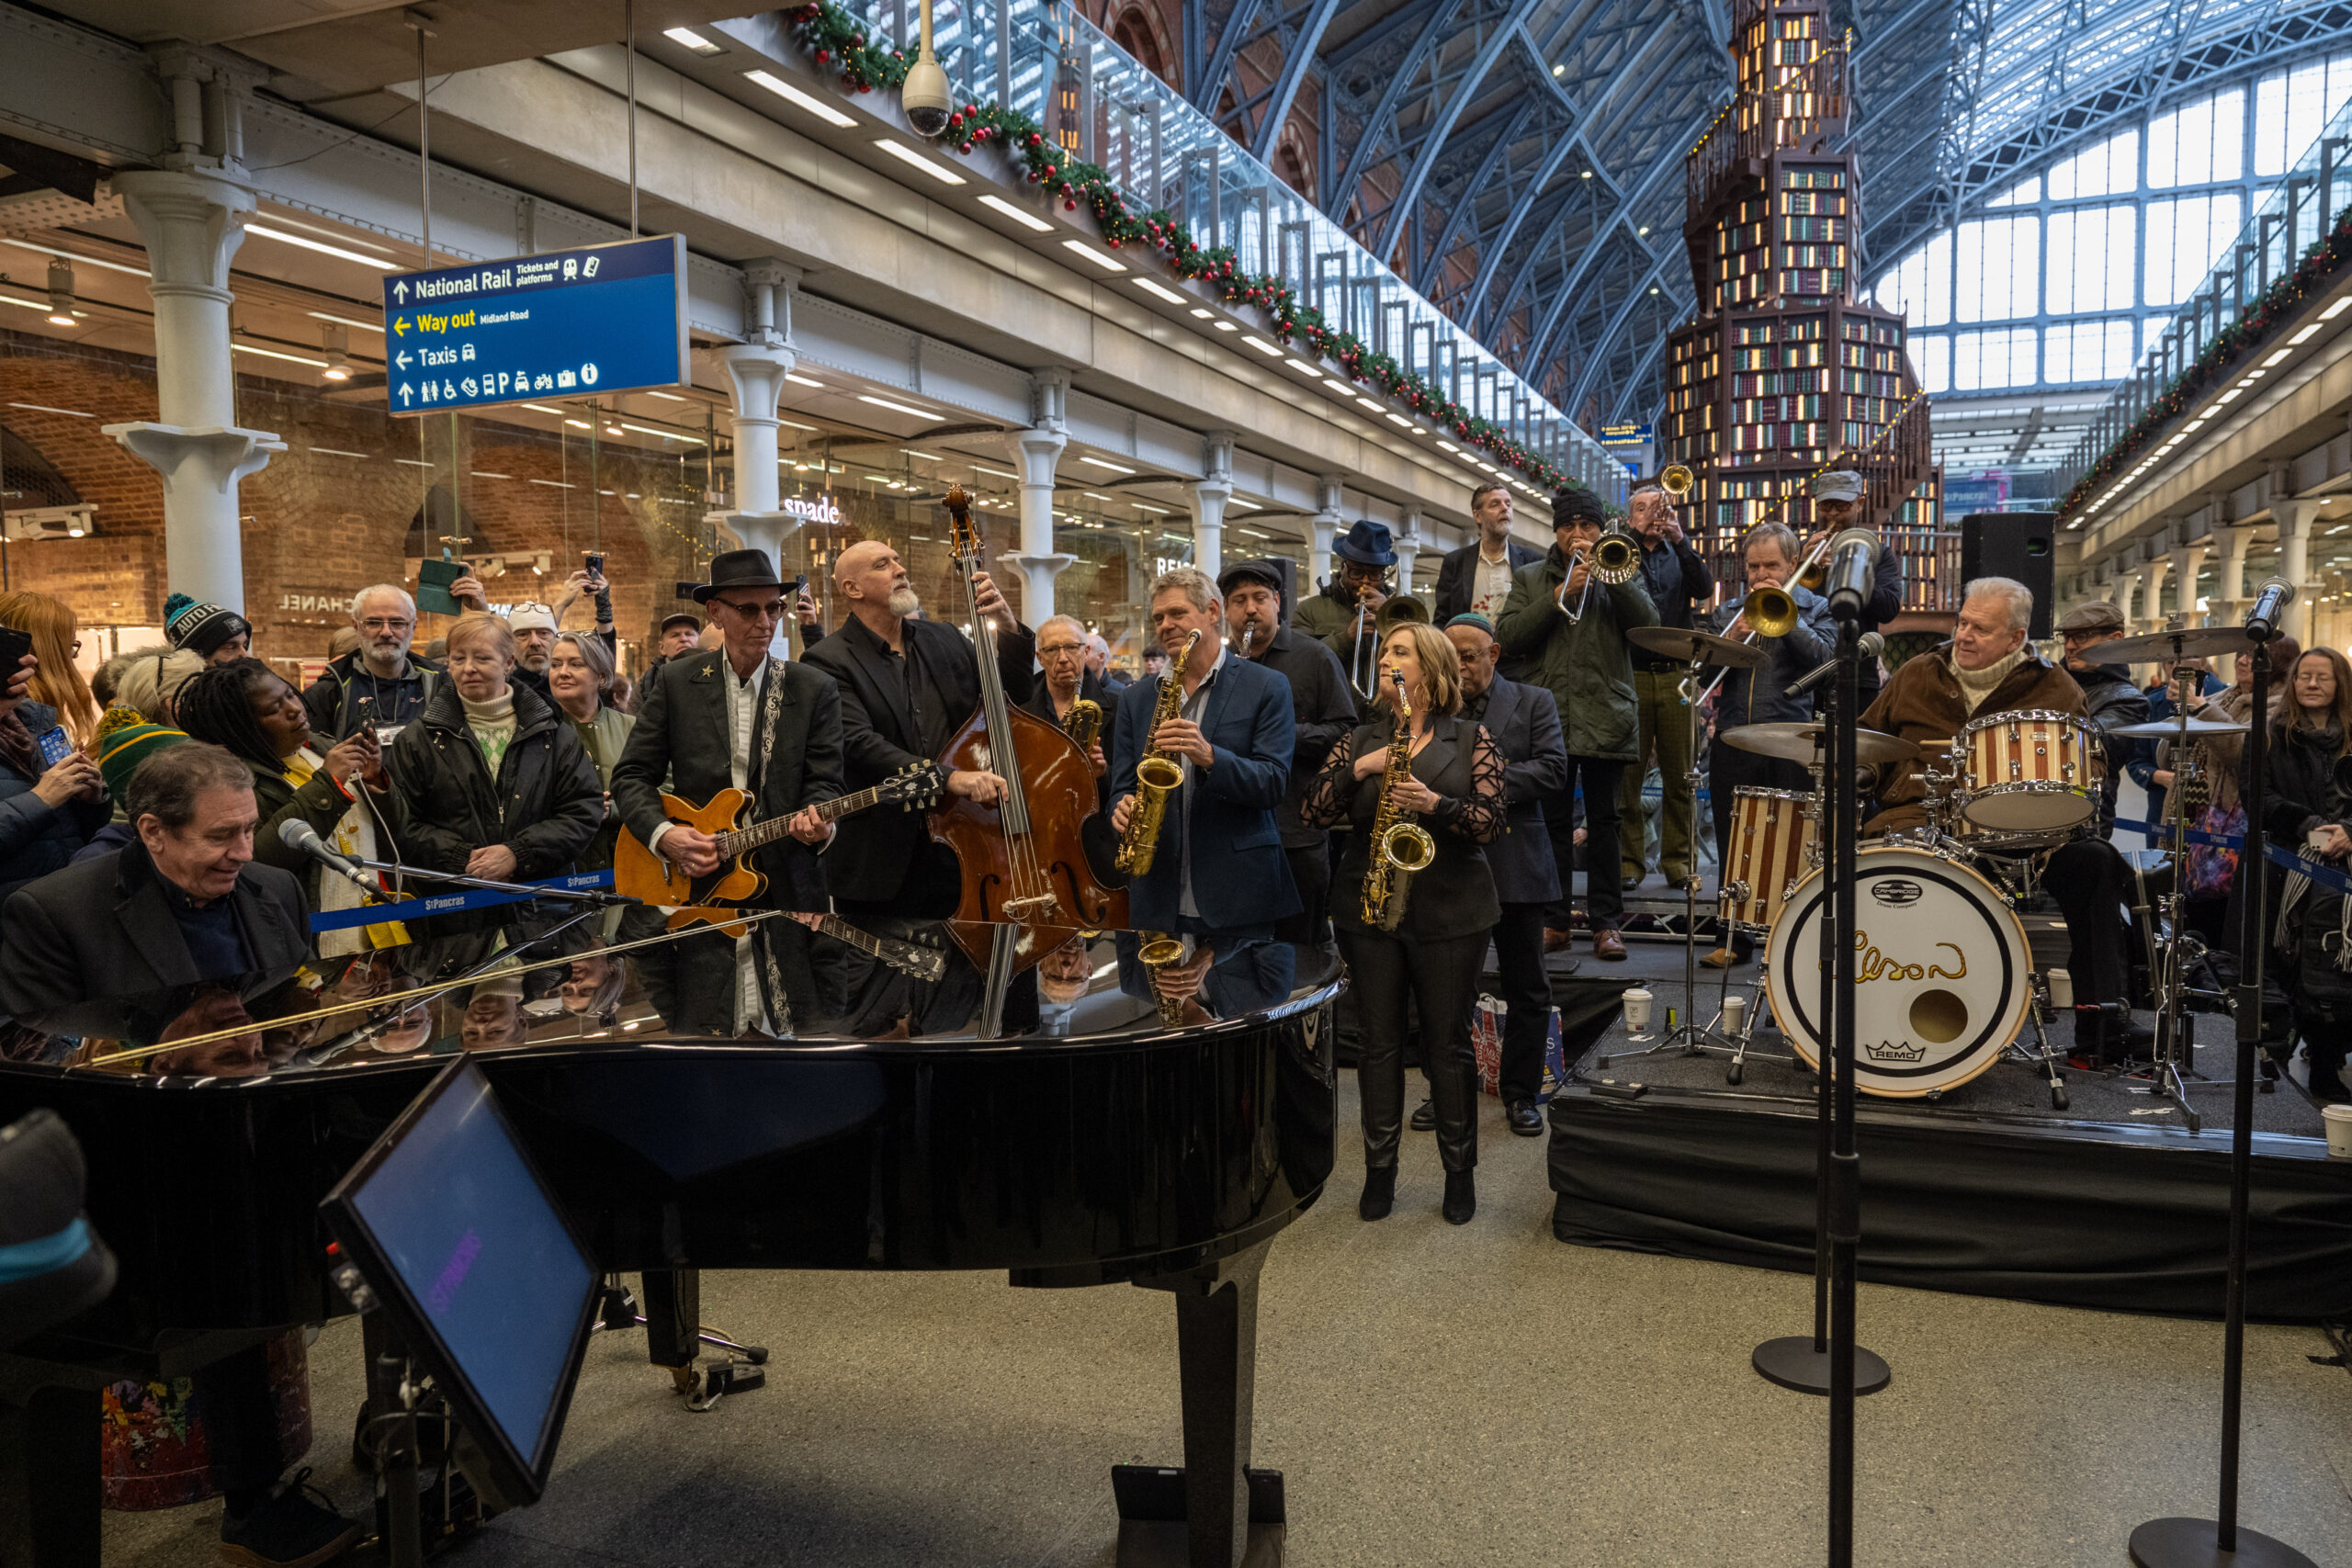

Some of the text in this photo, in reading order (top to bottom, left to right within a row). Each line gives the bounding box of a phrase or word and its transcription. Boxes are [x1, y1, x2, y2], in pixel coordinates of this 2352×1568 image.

[516, 259, 559, 275] Tickets and
[416, 269, 512, 299] National Rail
[516, 273, 553, 288] platforms
[416, 310, 476, 334] Way out
[480, 309, 529, 324] Midland Road
[418, 345, 458, 367] Taxis
[176, 607, 208, 636] AUTO
[1876, 1051, 1916, 1059] REMO
